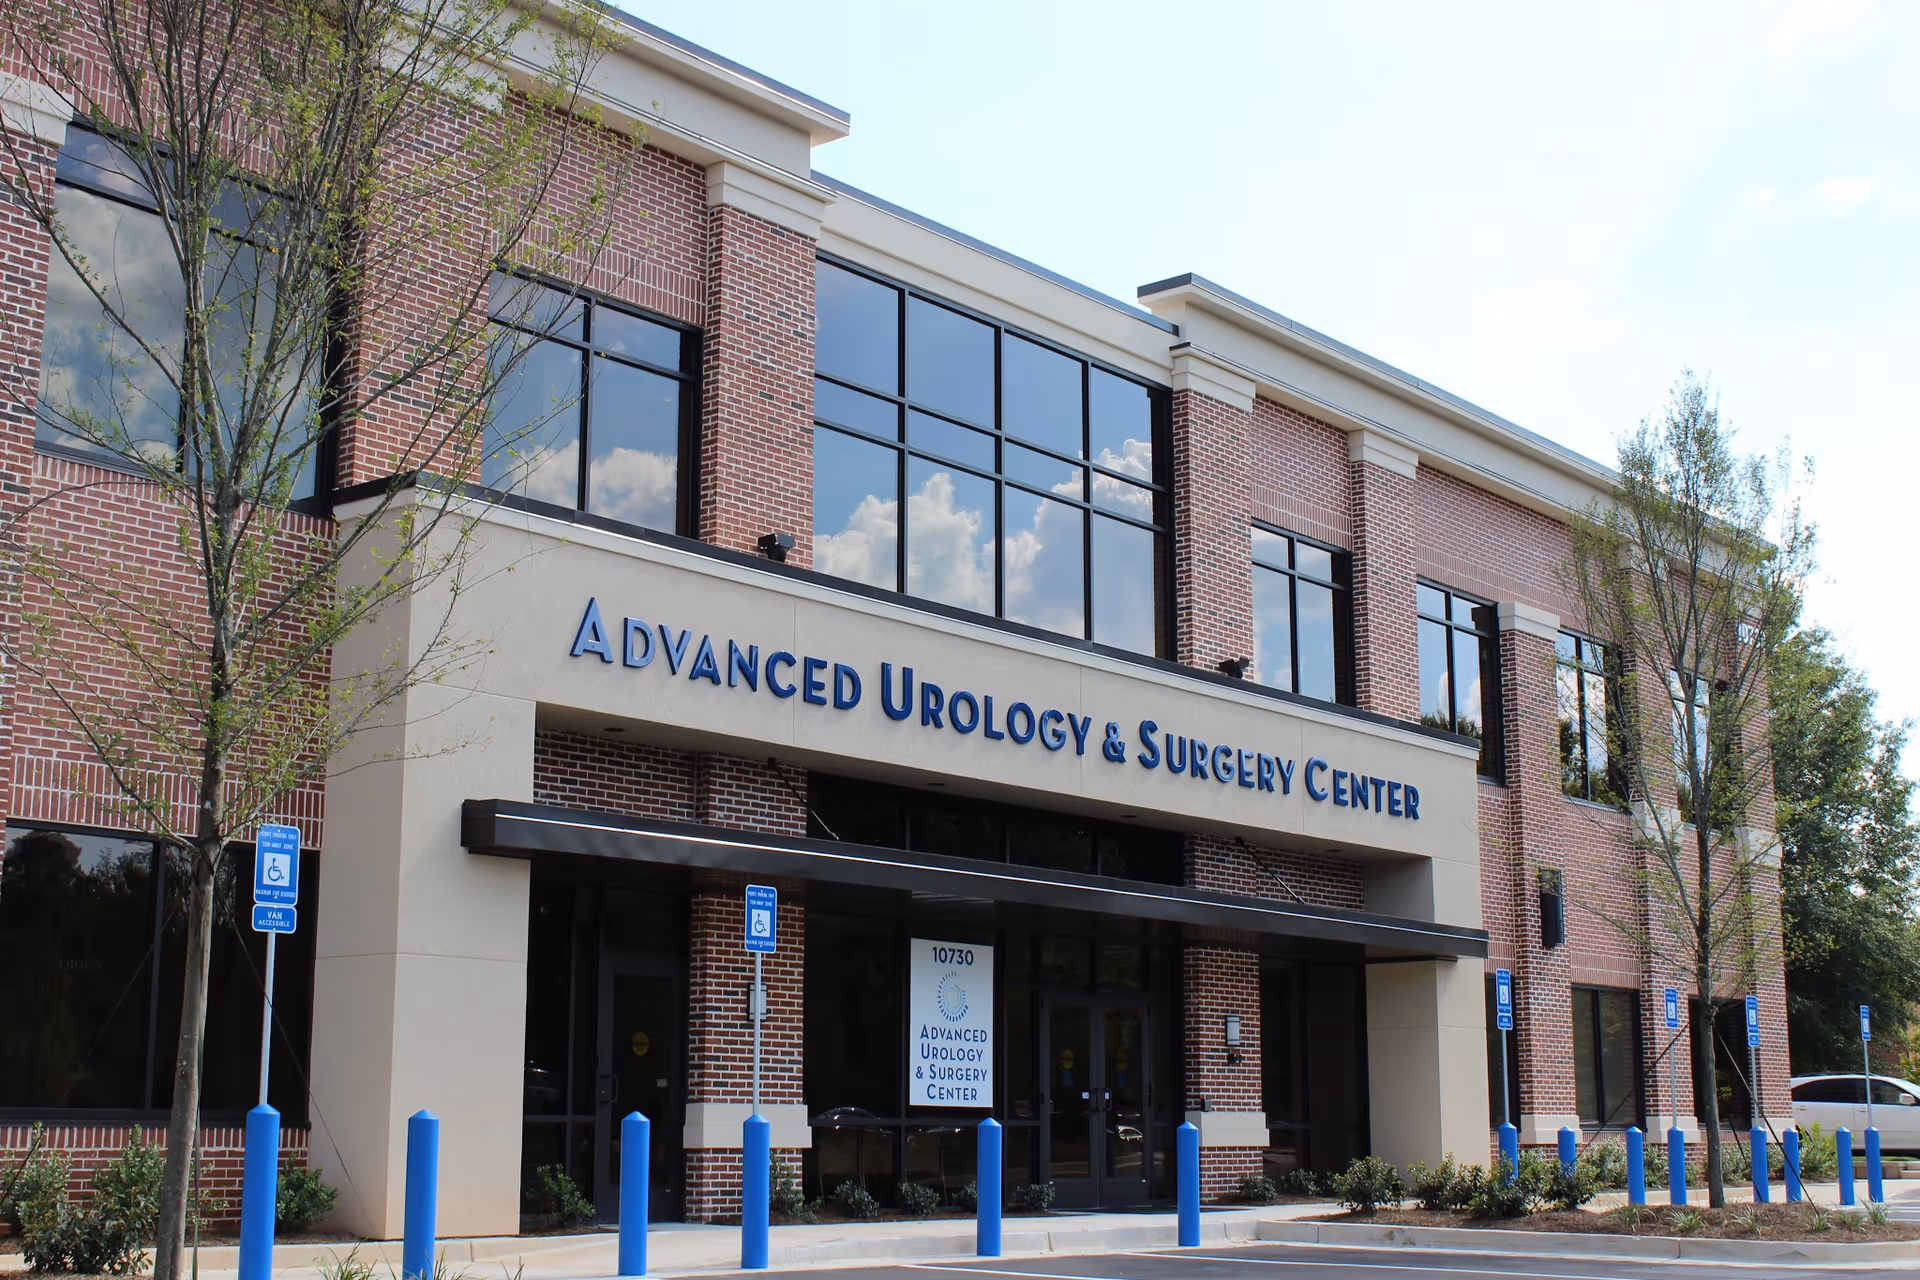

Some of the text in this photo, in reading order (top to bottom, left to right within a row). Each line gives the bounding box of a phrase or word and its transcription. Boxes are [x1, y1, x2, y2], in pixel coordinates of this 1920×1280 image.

[569, 597, 1420, 820] ADVANCED UROLOGY & SURGERY CENTER
[258, 919, 291, 928] ACCESSIBLE
[267, 910, 283, 920] VAN
[932, 946, 974, 966] 10730
[920, 1023, 988, 1043] ADVANCED
[921, 1043, 984, 1062] UROLOGY
[915, 1063, 988, 1082] & SURGERY
[926, 1083, 978, 1101] CENTER
